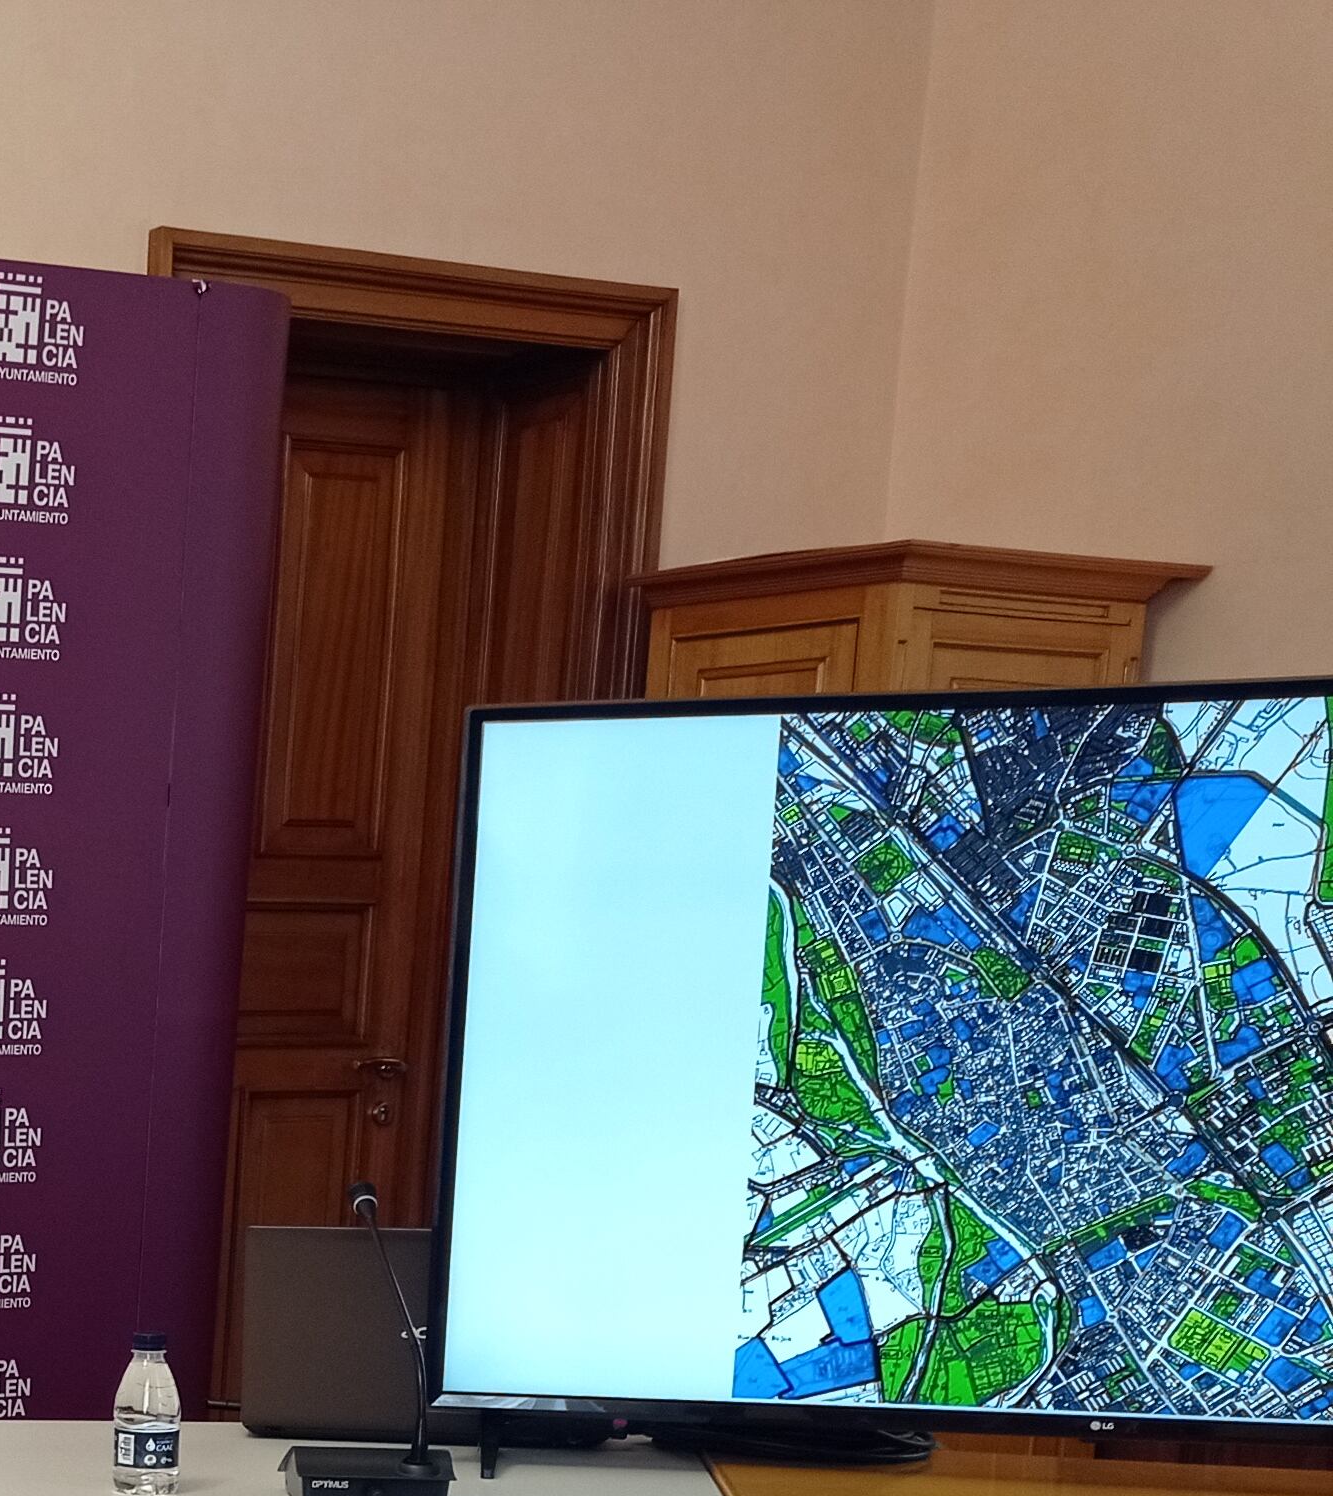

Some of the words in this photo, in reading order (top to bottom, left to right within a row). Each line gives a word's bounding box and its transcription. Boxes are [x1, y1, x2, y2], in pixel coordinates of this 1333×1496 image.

[45, 299, 72, 323] PA
[43, 322, 84, 347] LEN
[42, 344, 78, 369] CIA
[35, 440, 63, 463] PA
[34, 462, 76, 486] LEN
[32, 485, 69, 508] CIA
[27, 579, 54, 601] PA
[25, 600, 67, 623] LEN
[24, 622, 60, 645] CIA
[20, 714, 46, 736] PA
[18, 736, 59, 758] LEN
[17, 757, 53, 779] CIA
[15, 847, 41, 868] PA
[14, 868, 53, 889] LEN
[13, 889, 48, 910] CIA
[9, 978, 35, 999] PA
[8, 999, 47, 1019] LEN
[7, 1020, 42, 1040] CIA
[4, 1107, 30, 1127] PA
[3, 1127, 42, 1147] LEN
[2, 1148, 36, 1168] CIA
[0, 1234, 25, 1254] PA
[0, 1253, 36, 1274] LEN
[1102, 1422, 1115, 1430] LG
[311, 1479, 349, 1489] OPTIMUS
